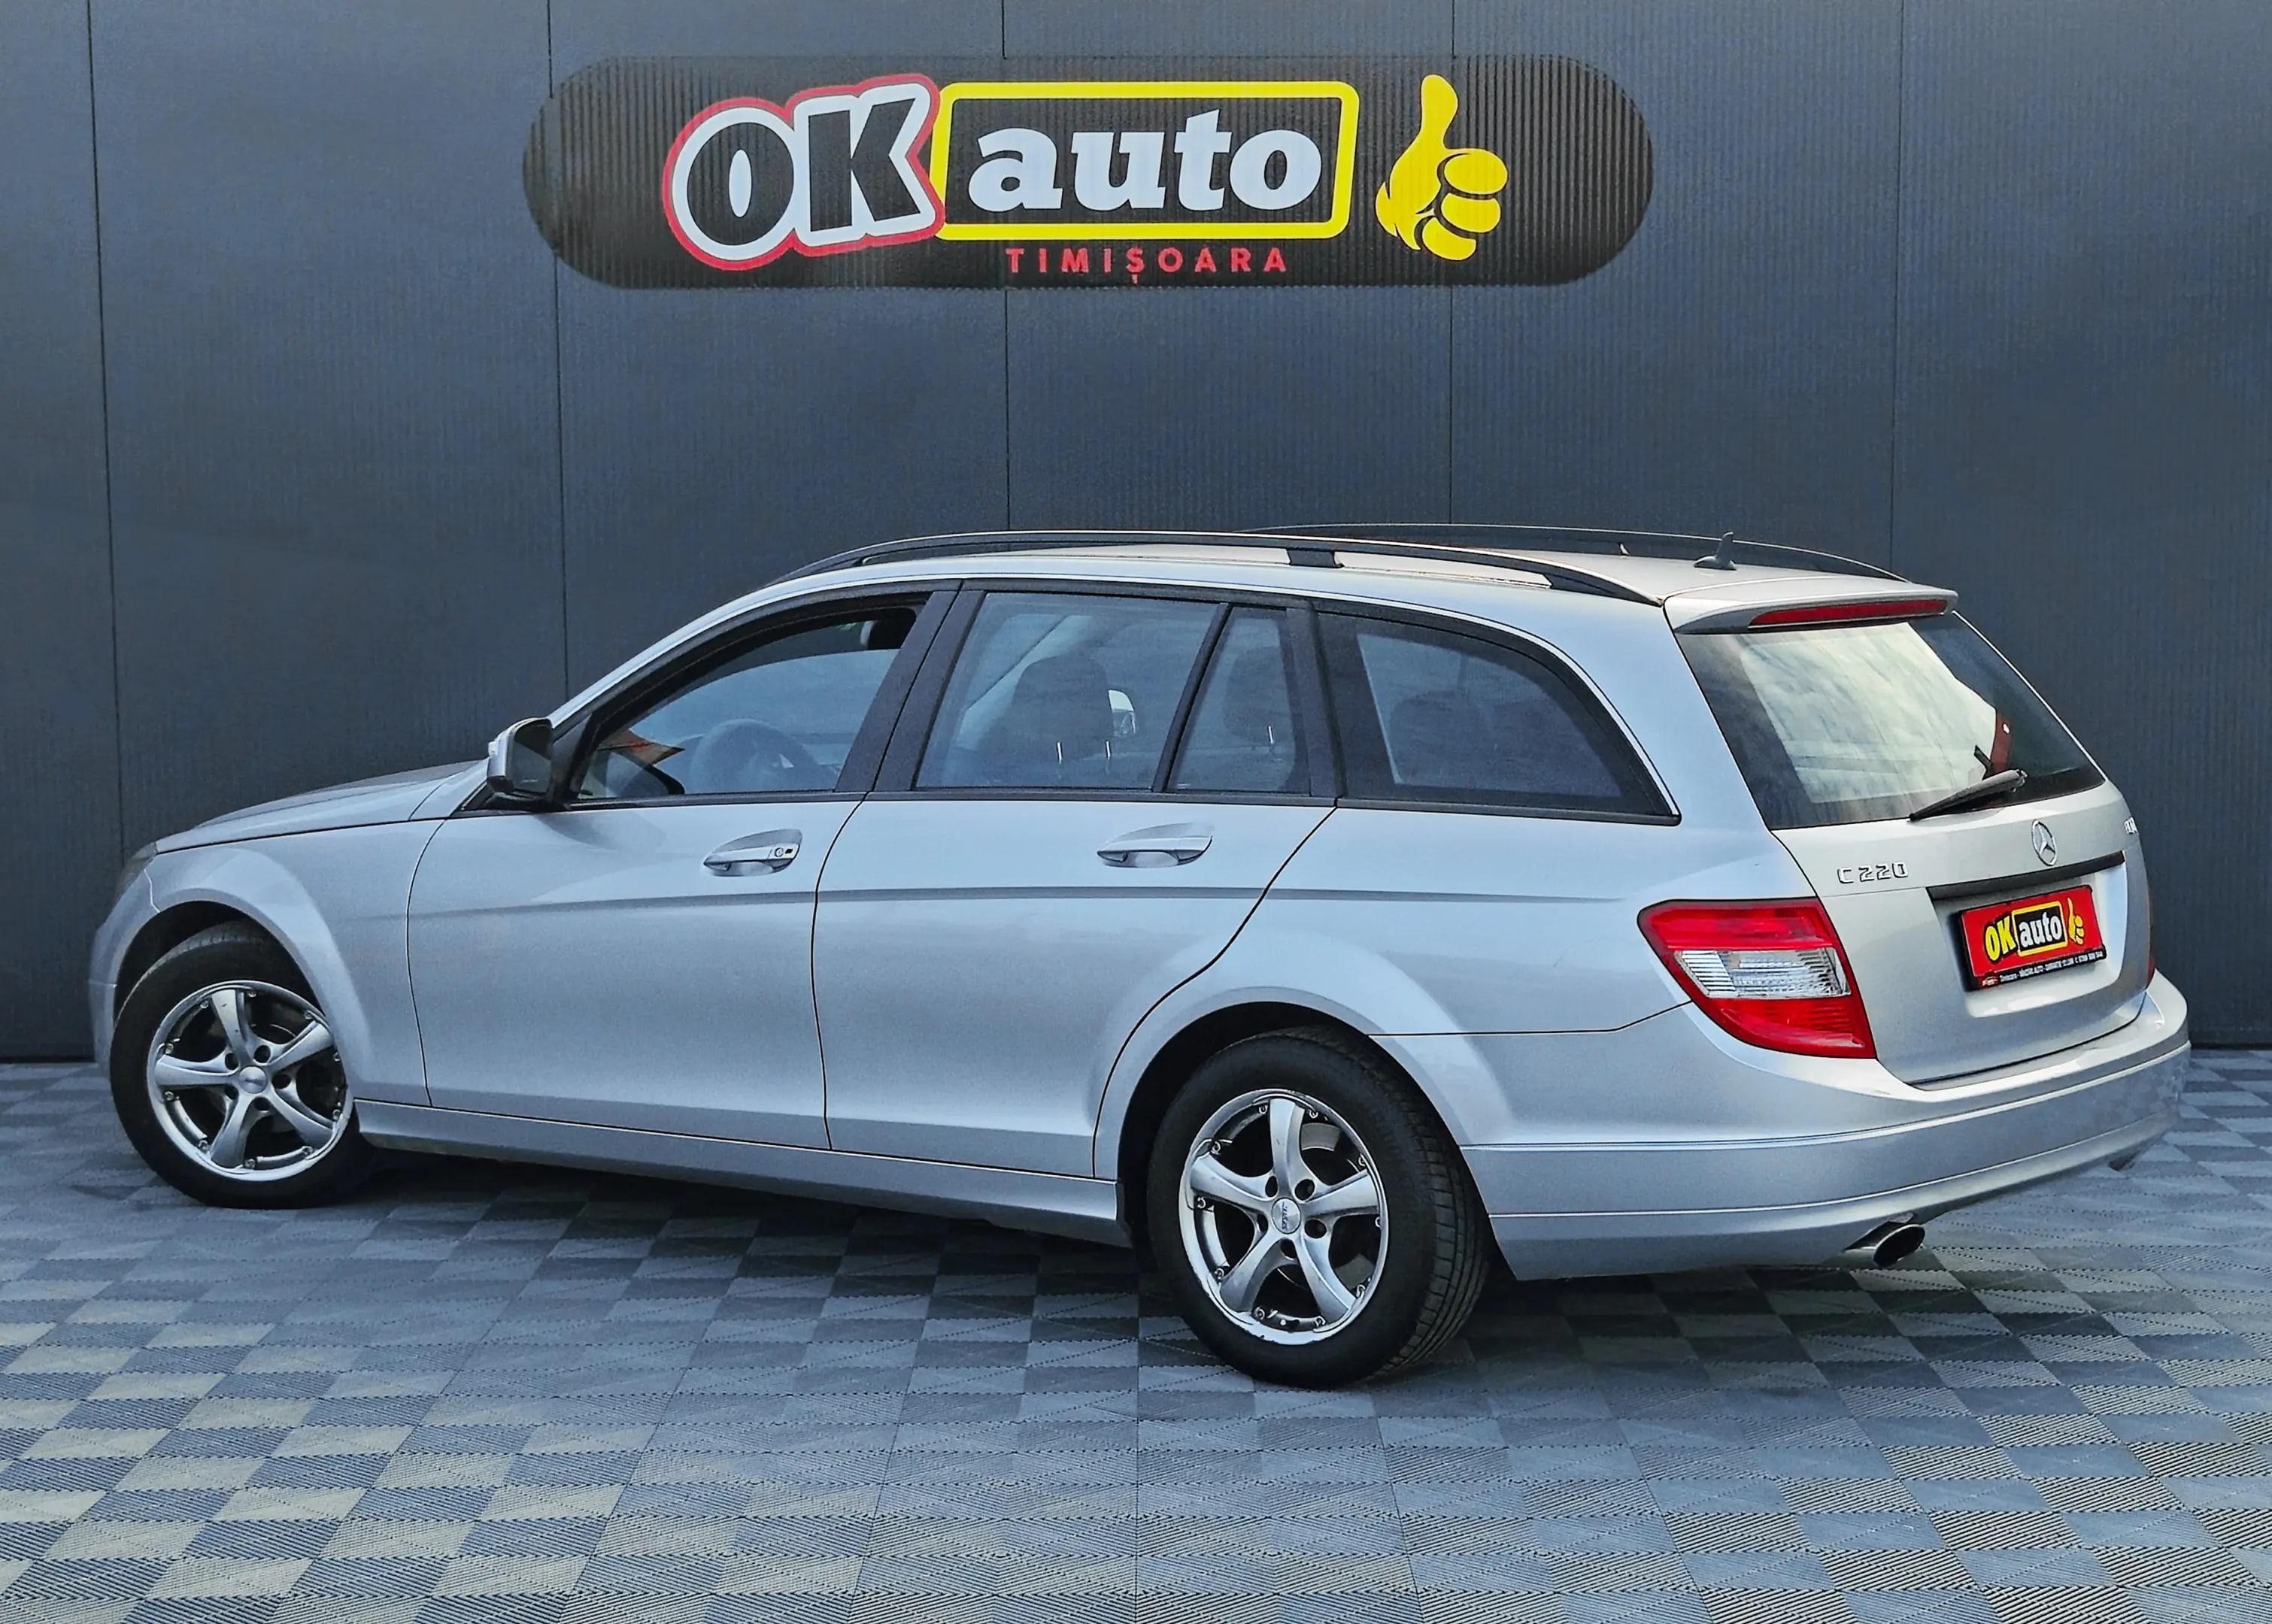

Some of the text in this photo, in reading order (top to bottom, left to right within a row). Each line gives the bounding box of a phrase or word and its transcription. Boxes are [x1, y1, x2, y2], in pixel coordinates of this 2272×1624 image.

[671, 81, 1321, 263] OK auto
[1837, 862, 1908, 883] C 220
[1985, 911, 2062, 961] OK auto
